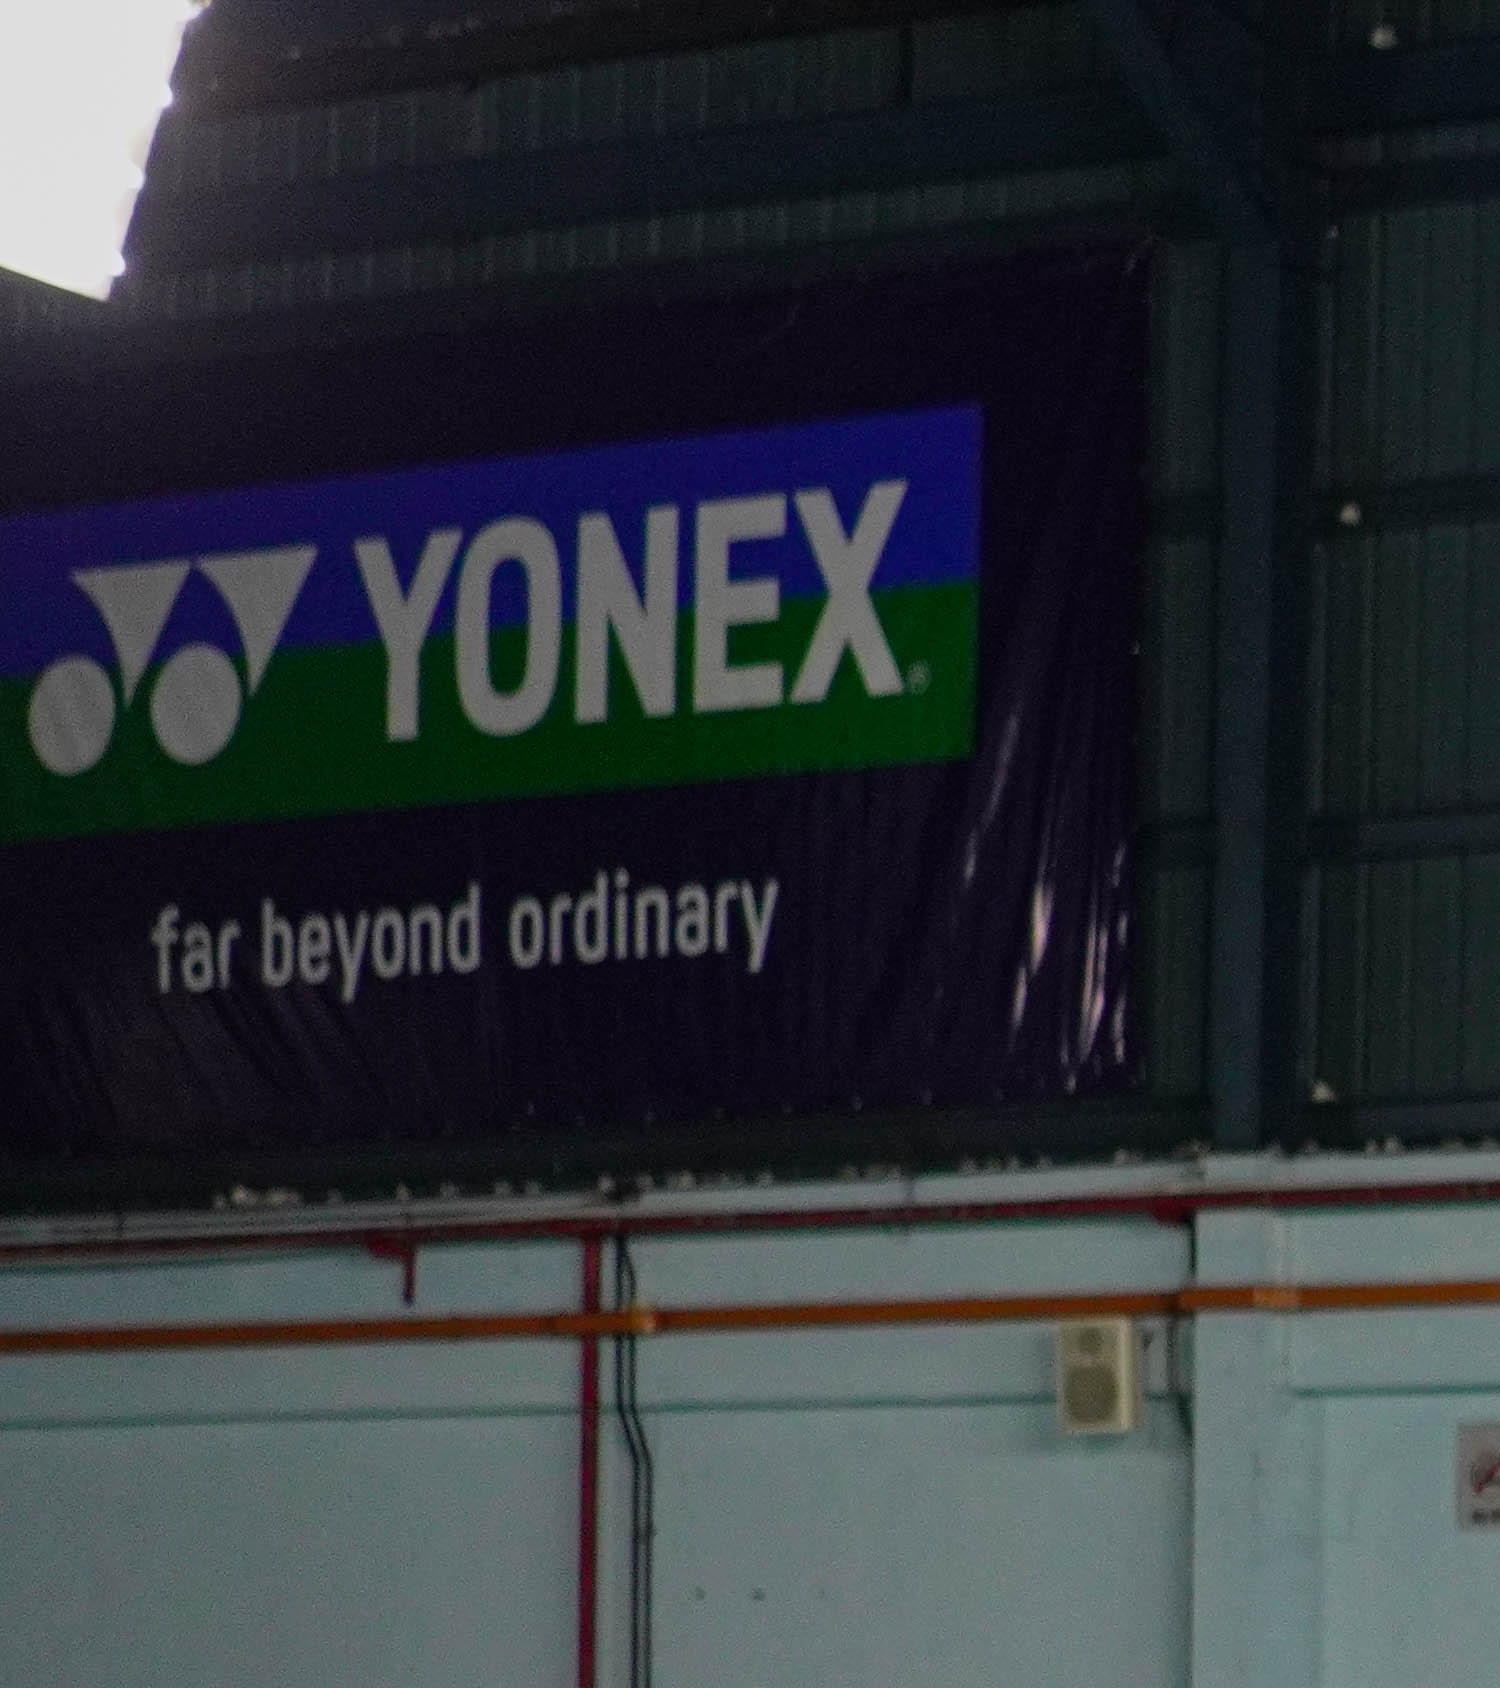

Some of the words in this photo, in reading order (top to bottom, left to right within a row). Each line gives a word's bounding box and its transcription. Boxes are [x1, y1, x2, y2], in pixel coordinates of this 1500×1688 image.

[353, 477, 909, 742] YONEX
[150, 902, 240, 996] far
[260, 881, 482, 1004] beyond
[509, 867, 780, 974] ordinary
